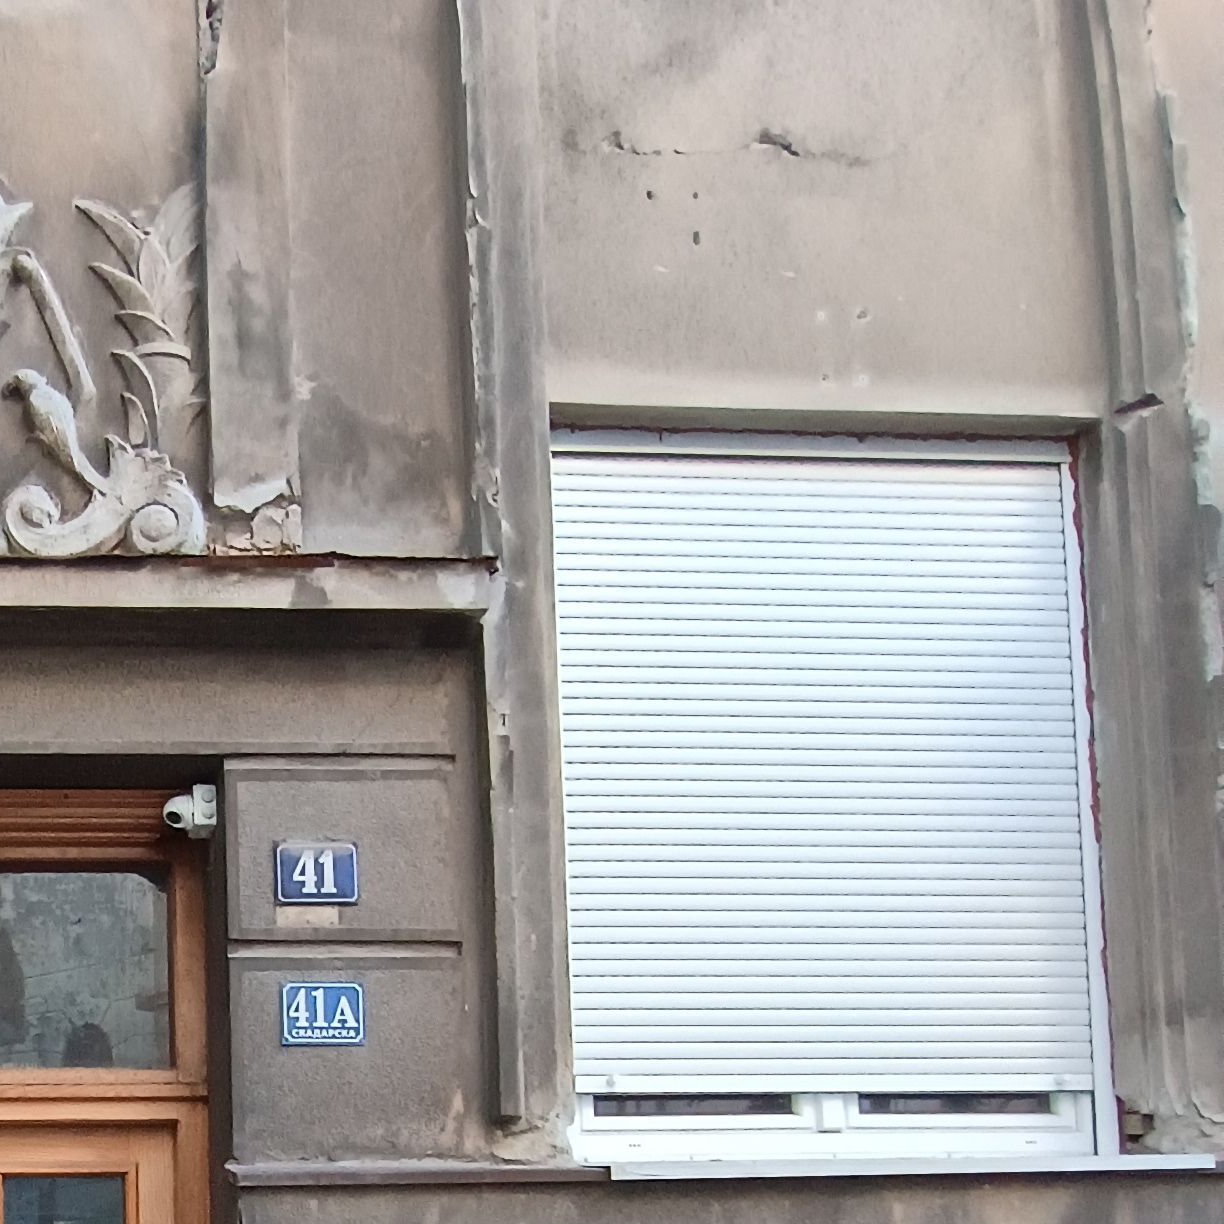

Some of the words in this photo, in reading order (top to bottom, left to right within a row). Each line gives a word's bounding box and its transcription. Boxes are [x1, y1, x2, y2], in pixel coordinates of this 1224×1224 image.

[292, 849, 337, 894] 41
[288, 987, 358, 1027] 41A
[291, 1028, 356, 1039] СКАДАРСКА
